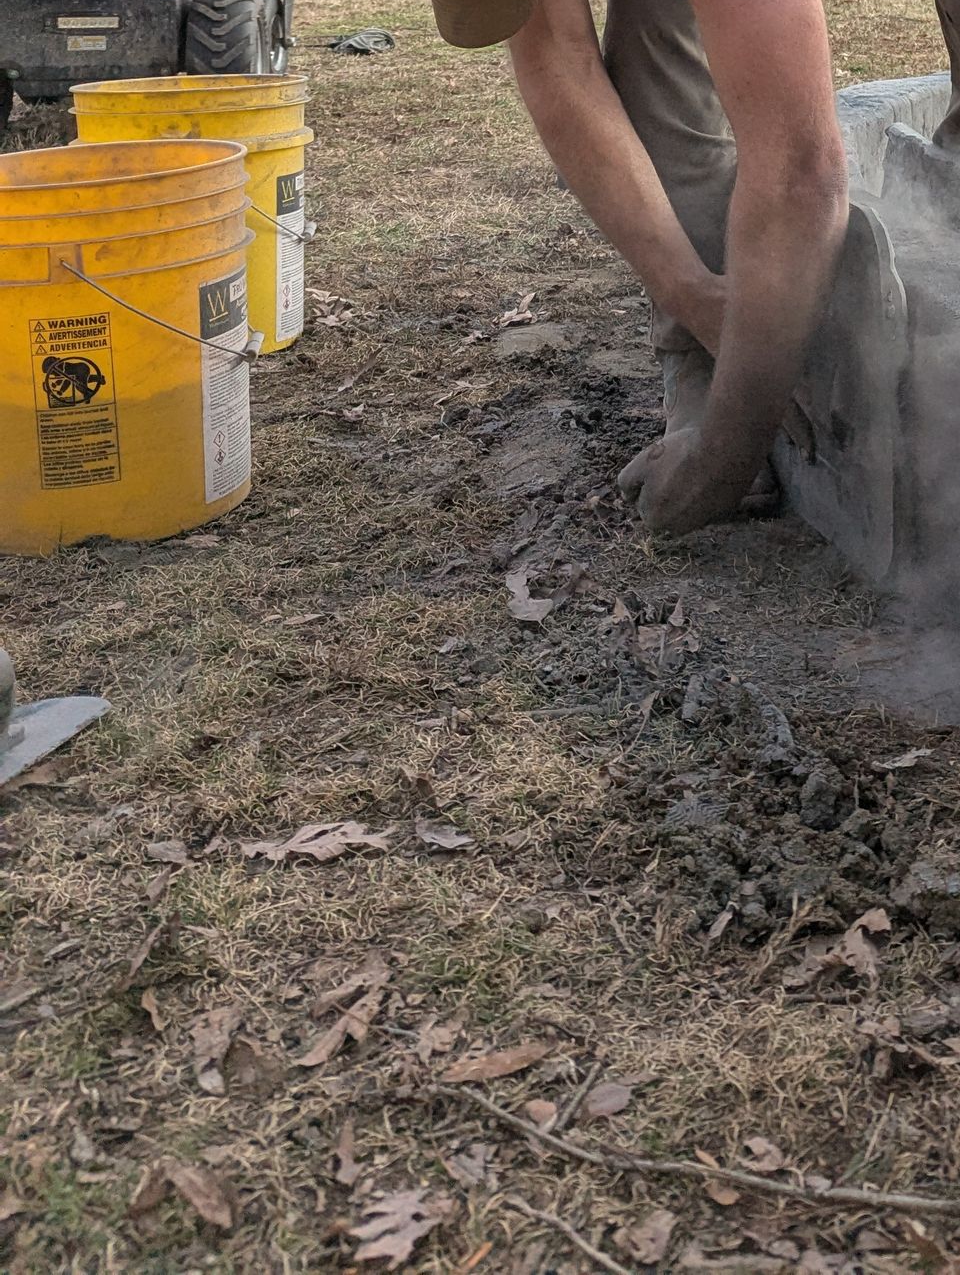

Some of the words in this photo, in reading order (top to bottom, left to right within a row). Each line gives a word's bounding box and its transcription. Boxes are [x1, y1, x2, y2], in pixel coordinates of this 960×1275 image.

[47, 315, 107, 329] WARNING
[48, 327, 107, 341] AVERTISSEMENT
[49, 339, 107, 353] ADVERTENCIA
